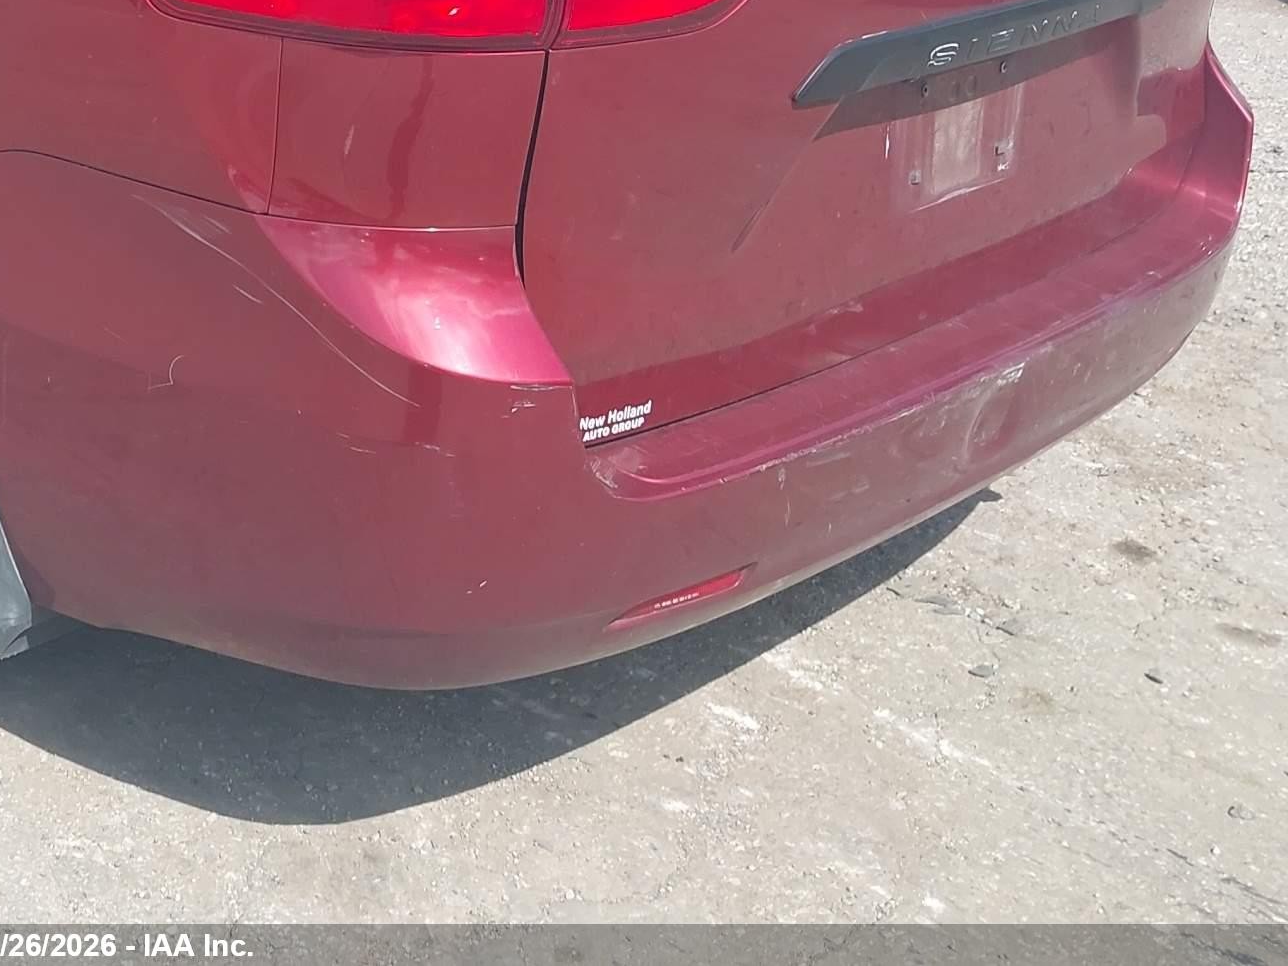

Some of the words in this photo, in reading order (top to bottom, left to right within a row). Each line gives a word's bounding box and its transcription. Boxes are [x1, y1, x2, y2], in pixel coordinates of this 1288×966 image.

[579, 414, 606, 431] New
[607, 399, 652, 425] Holland
[582, 427, 610, 442] AUTO
[611, 416, 645, 435] GROUP
